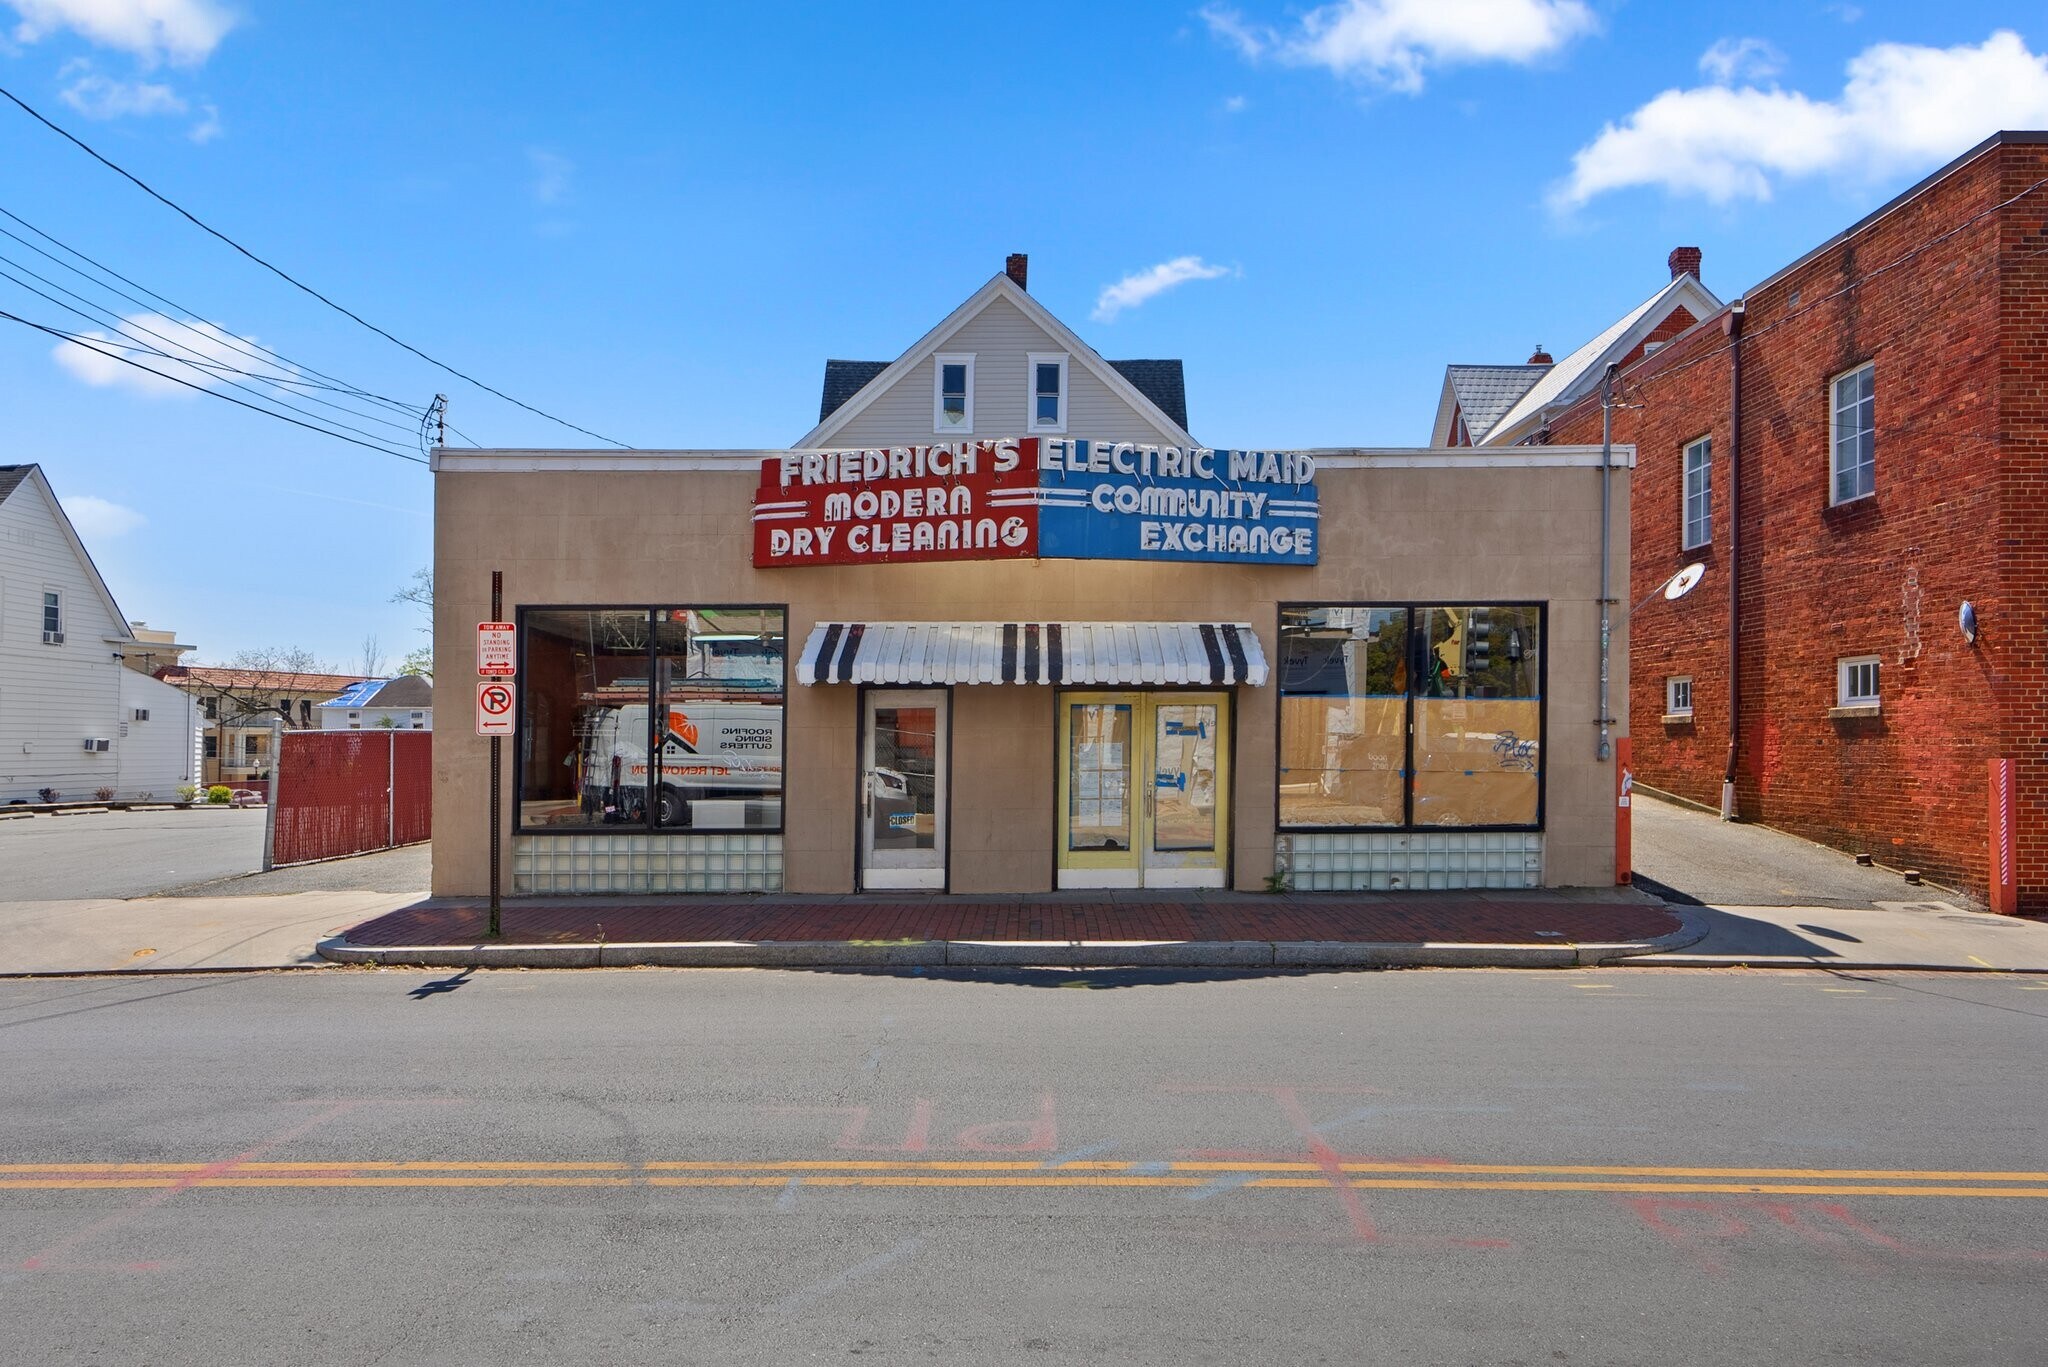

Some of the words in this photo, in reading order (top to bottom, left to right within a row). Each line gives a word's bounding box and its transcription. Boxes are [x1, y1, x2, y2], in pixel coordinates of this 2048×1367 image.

[780, 439, 1020, 487] FRIEDRICH'S
[1041, 438, 1216, 480] ELECTRIC
[1229, 450, 1315, 486] MAID
[824, 485, 972, 522] MODERN
[1091, 483, 1268, 520] COMMUNITY
[770, 526, 836, 557] DRY
[847, 516, 1029, 553] CLEANING
[1140, 521, 1313, 555] EXCHANGE
[890, 816, 914, 825] CLOSED
